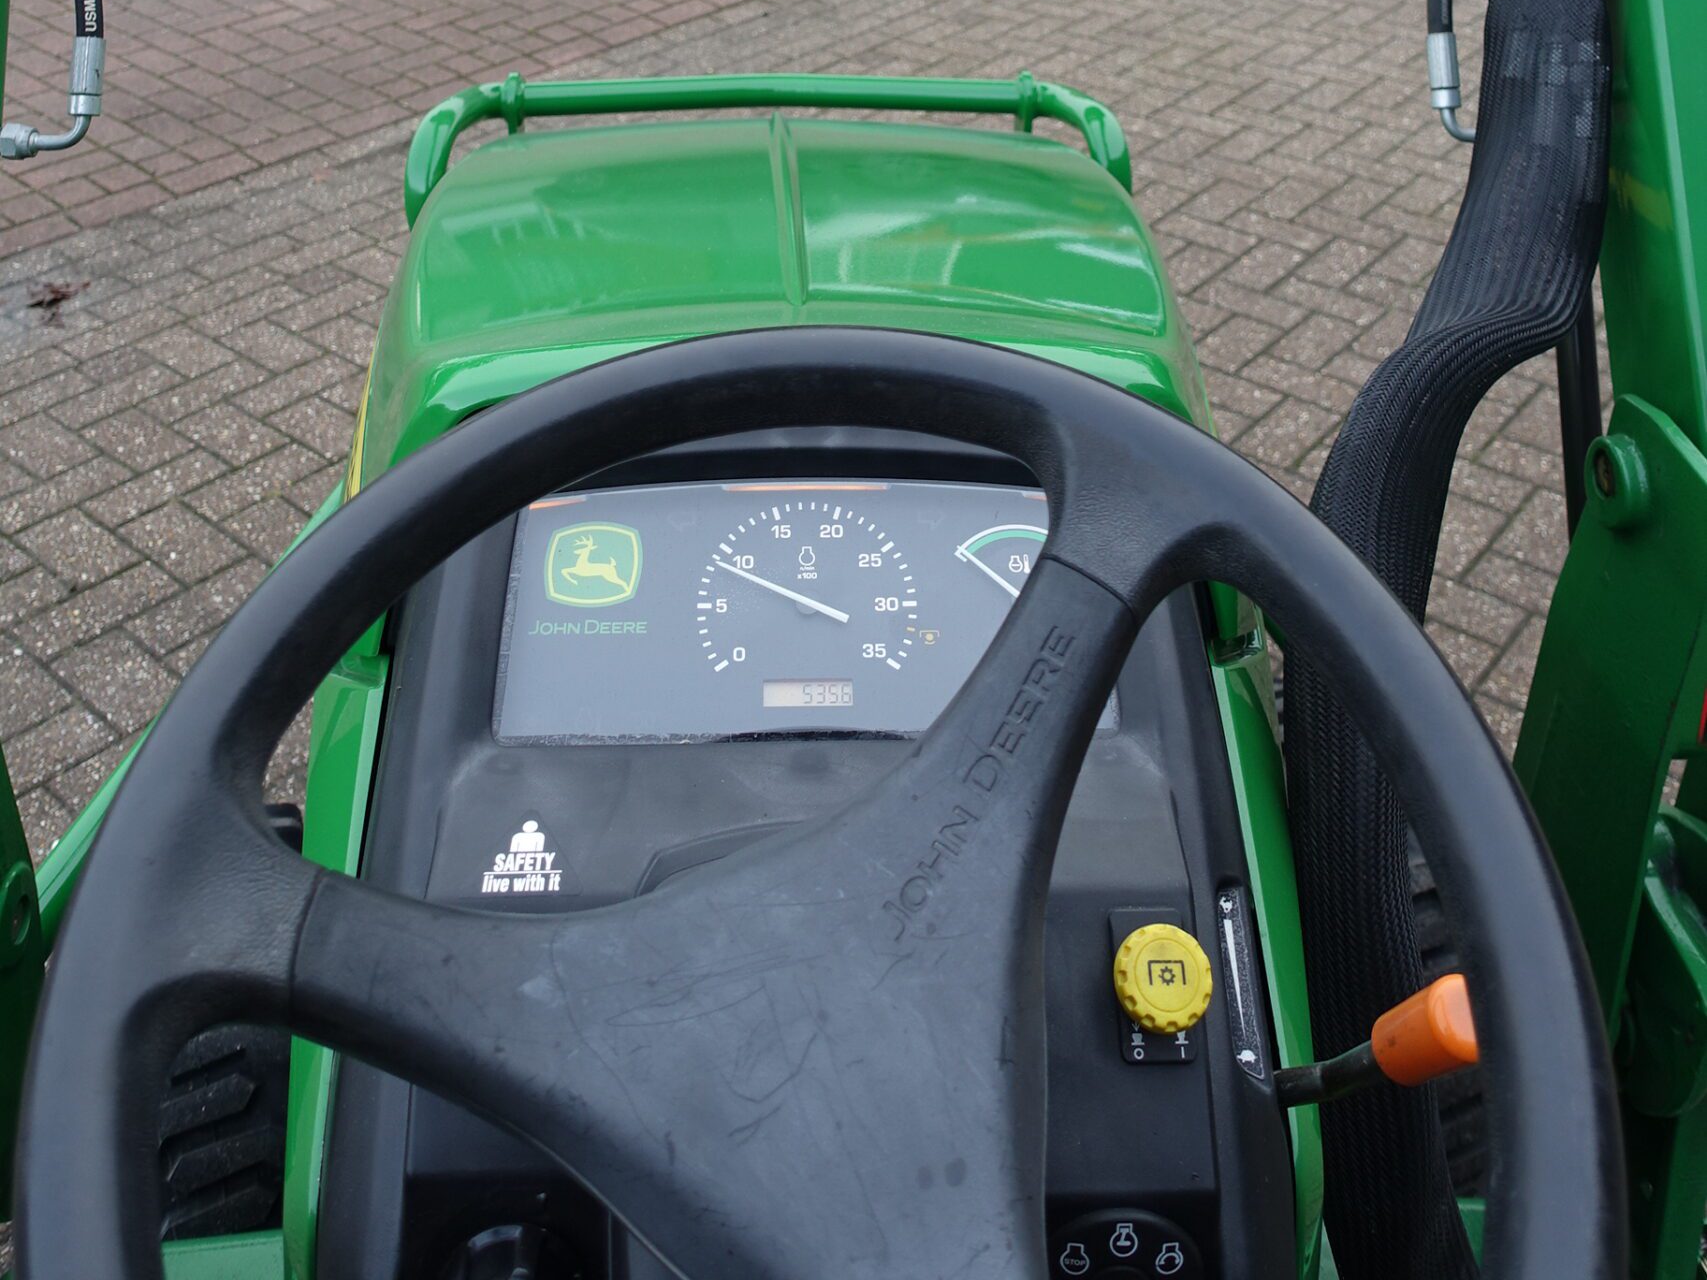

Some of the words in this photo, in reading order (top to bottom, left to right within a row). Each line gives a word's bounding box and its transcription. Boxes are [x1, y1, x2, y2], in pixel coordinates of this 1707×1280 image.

[771, 524, 792, 539] 15
[819, 524, 844, 538] 20
[733, 554, 754, 569] 10
[858, 553, 882, 567] 25
[715, 598, 728, 613] 5
[874, 597, 899, 611] 30
[733, 646, 746, 662] 0
[862, 643, 887, 658] 35
[882, 804, 980, 942] JOHN
[962, 625, 1077, 793] DEERE
[493, 851, 556, 872] SAFETY
[481, 874, 510, 893] live
[513, 873, 545, 892] with
[548, 872, 561, 891] it
